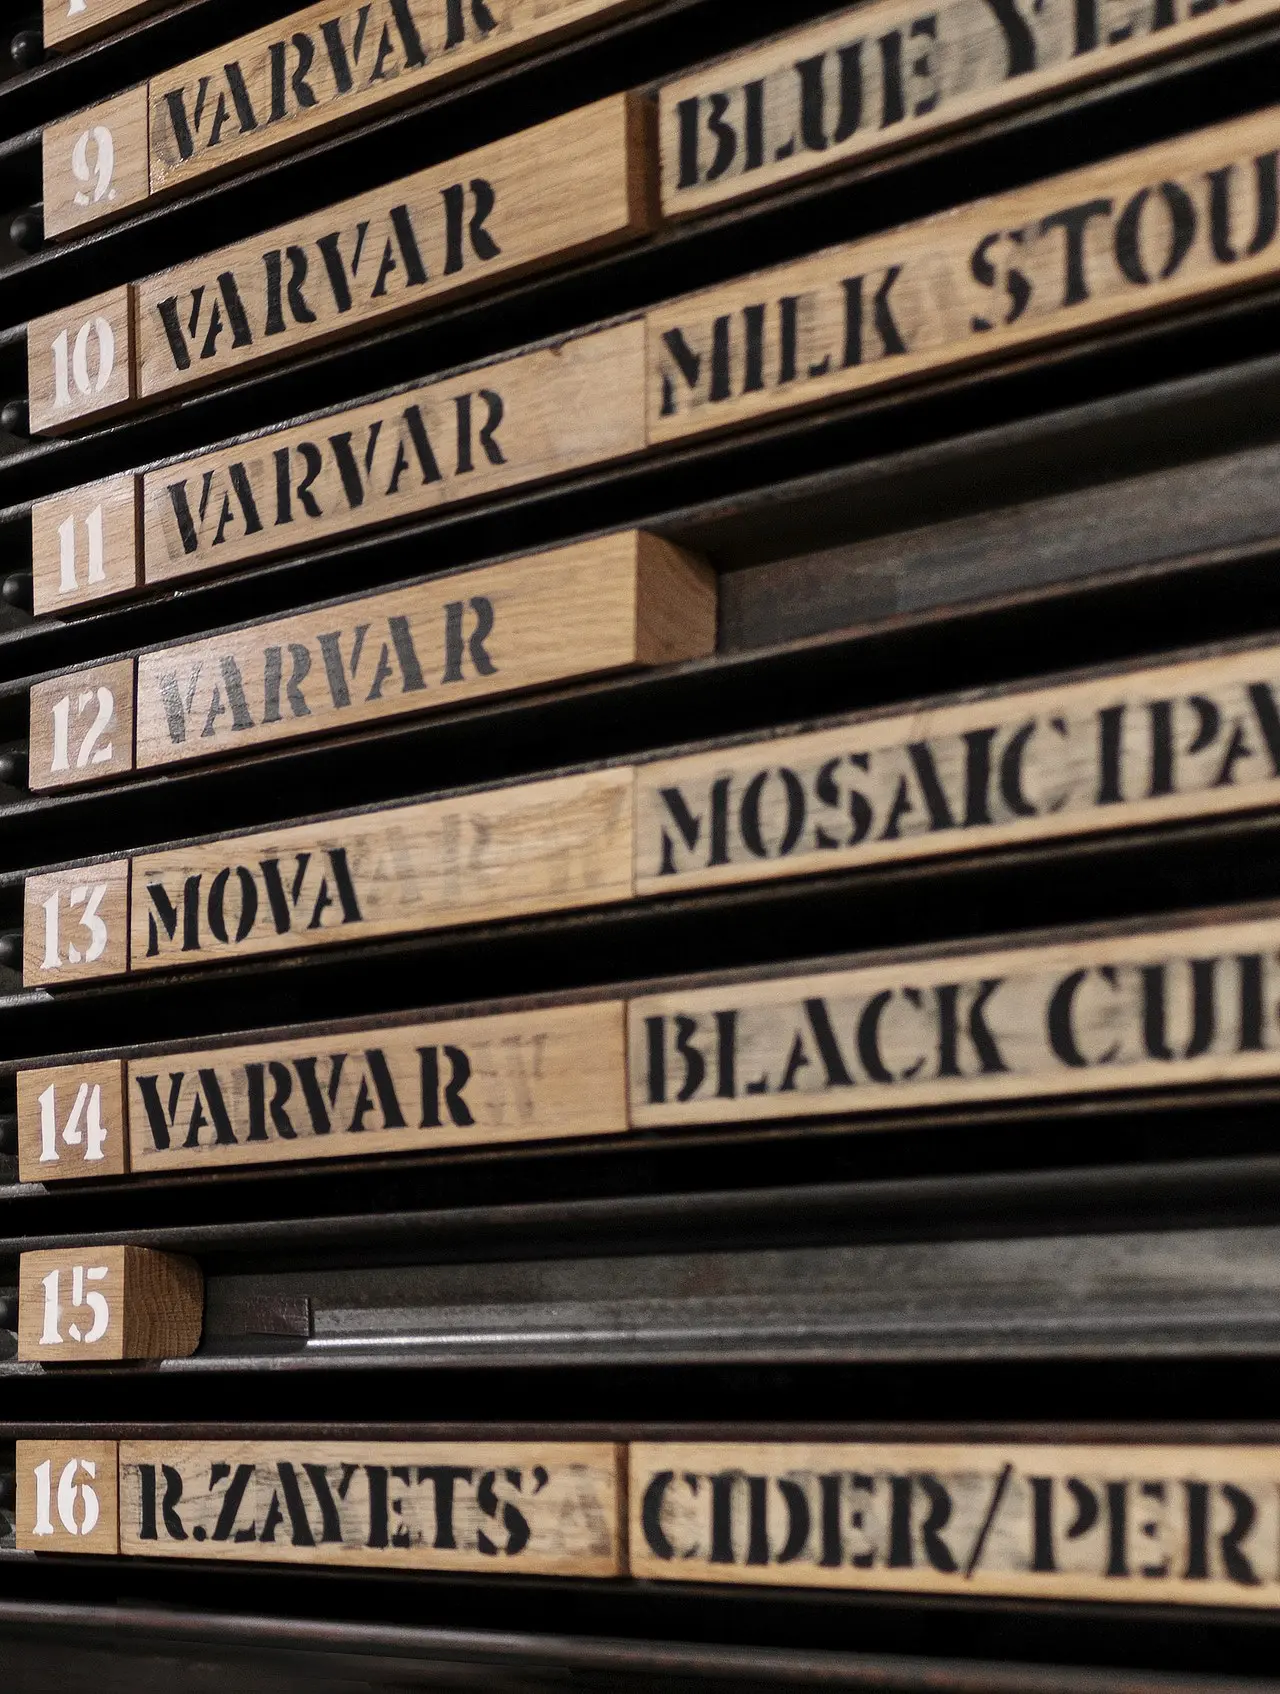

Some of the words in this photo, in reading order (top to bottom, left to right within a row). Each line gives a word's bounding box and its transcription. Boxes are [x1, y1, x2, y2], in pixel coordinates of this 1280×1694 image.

[675, 15, 941, 191] BLUE
[156, 178, 502, 372] VARVAR
[51, 316, 115, 408] 10
[659, 263, 907, 418] MILK
[166, 389, 509, 556] VARVAR
[56, 503, 107, 594] 11
[158, 596, 499, 745] VARVAR
[50, 686, 115, 773] 12
[656, 714, 1072, 876] MOSAIC
[1094, 681, 1280, 806] IPA
[39, 883, 109, 970] 13
[145, 846, 364, 959] MOVA
[135, 1044, 476, 1151] VARVAR
[644, 977, 1013, 1105] BLACK
[36, 1082, 108, 1162] 14
[37, 1265, 109, 1346] 15
[31, 1456, 101, 1537] 16
[640, 1461, 1280, 1588] CIDER/PER
